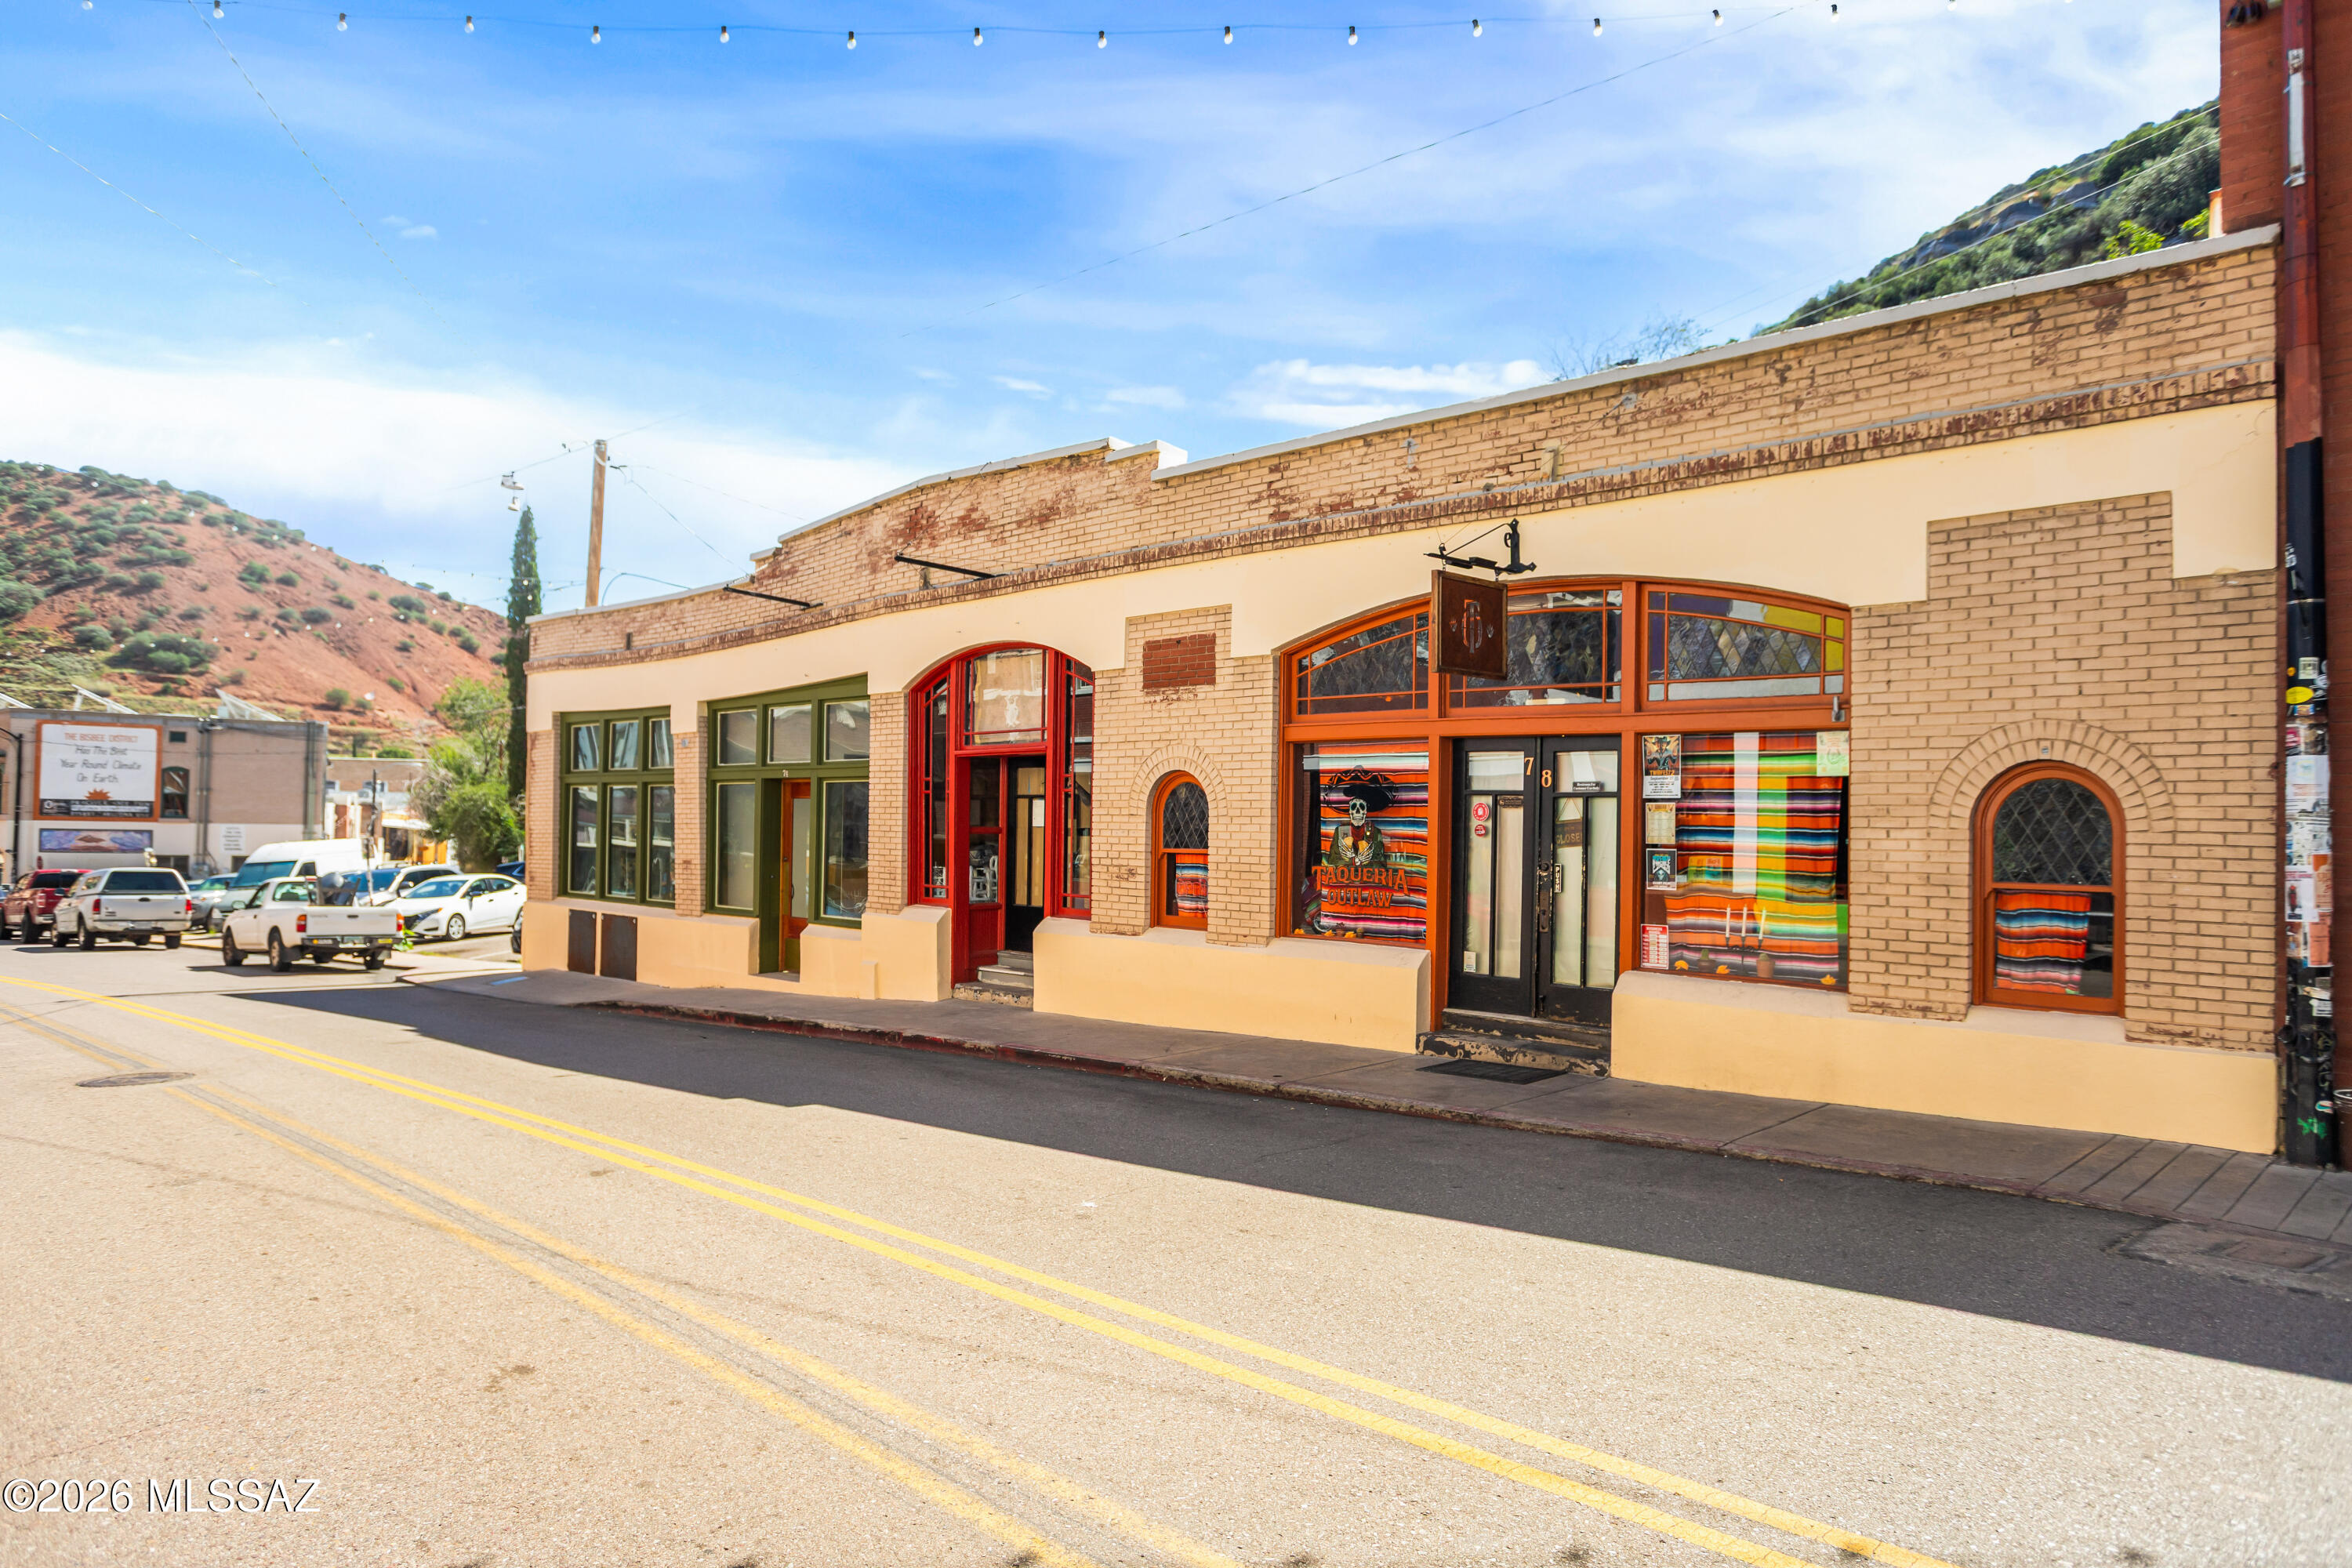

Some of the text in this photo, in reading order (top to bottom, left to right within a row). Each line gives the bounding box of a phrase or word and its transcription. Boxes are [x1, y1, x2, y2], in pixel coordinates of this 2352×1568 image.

[64, 732, 138, 743] THE BISBEE DISTRICT
[75, 746, 128, 756] Has The Best
[60, 759, 142, 770] Year Round Climate
[77, 773, 118, 782] On Earth
[1555, 833, 1582, 844] CLOSE
[1312, 865, 1410, 895] TAQUERIA
[1327, 887, 1393, 909] OUTLAW
